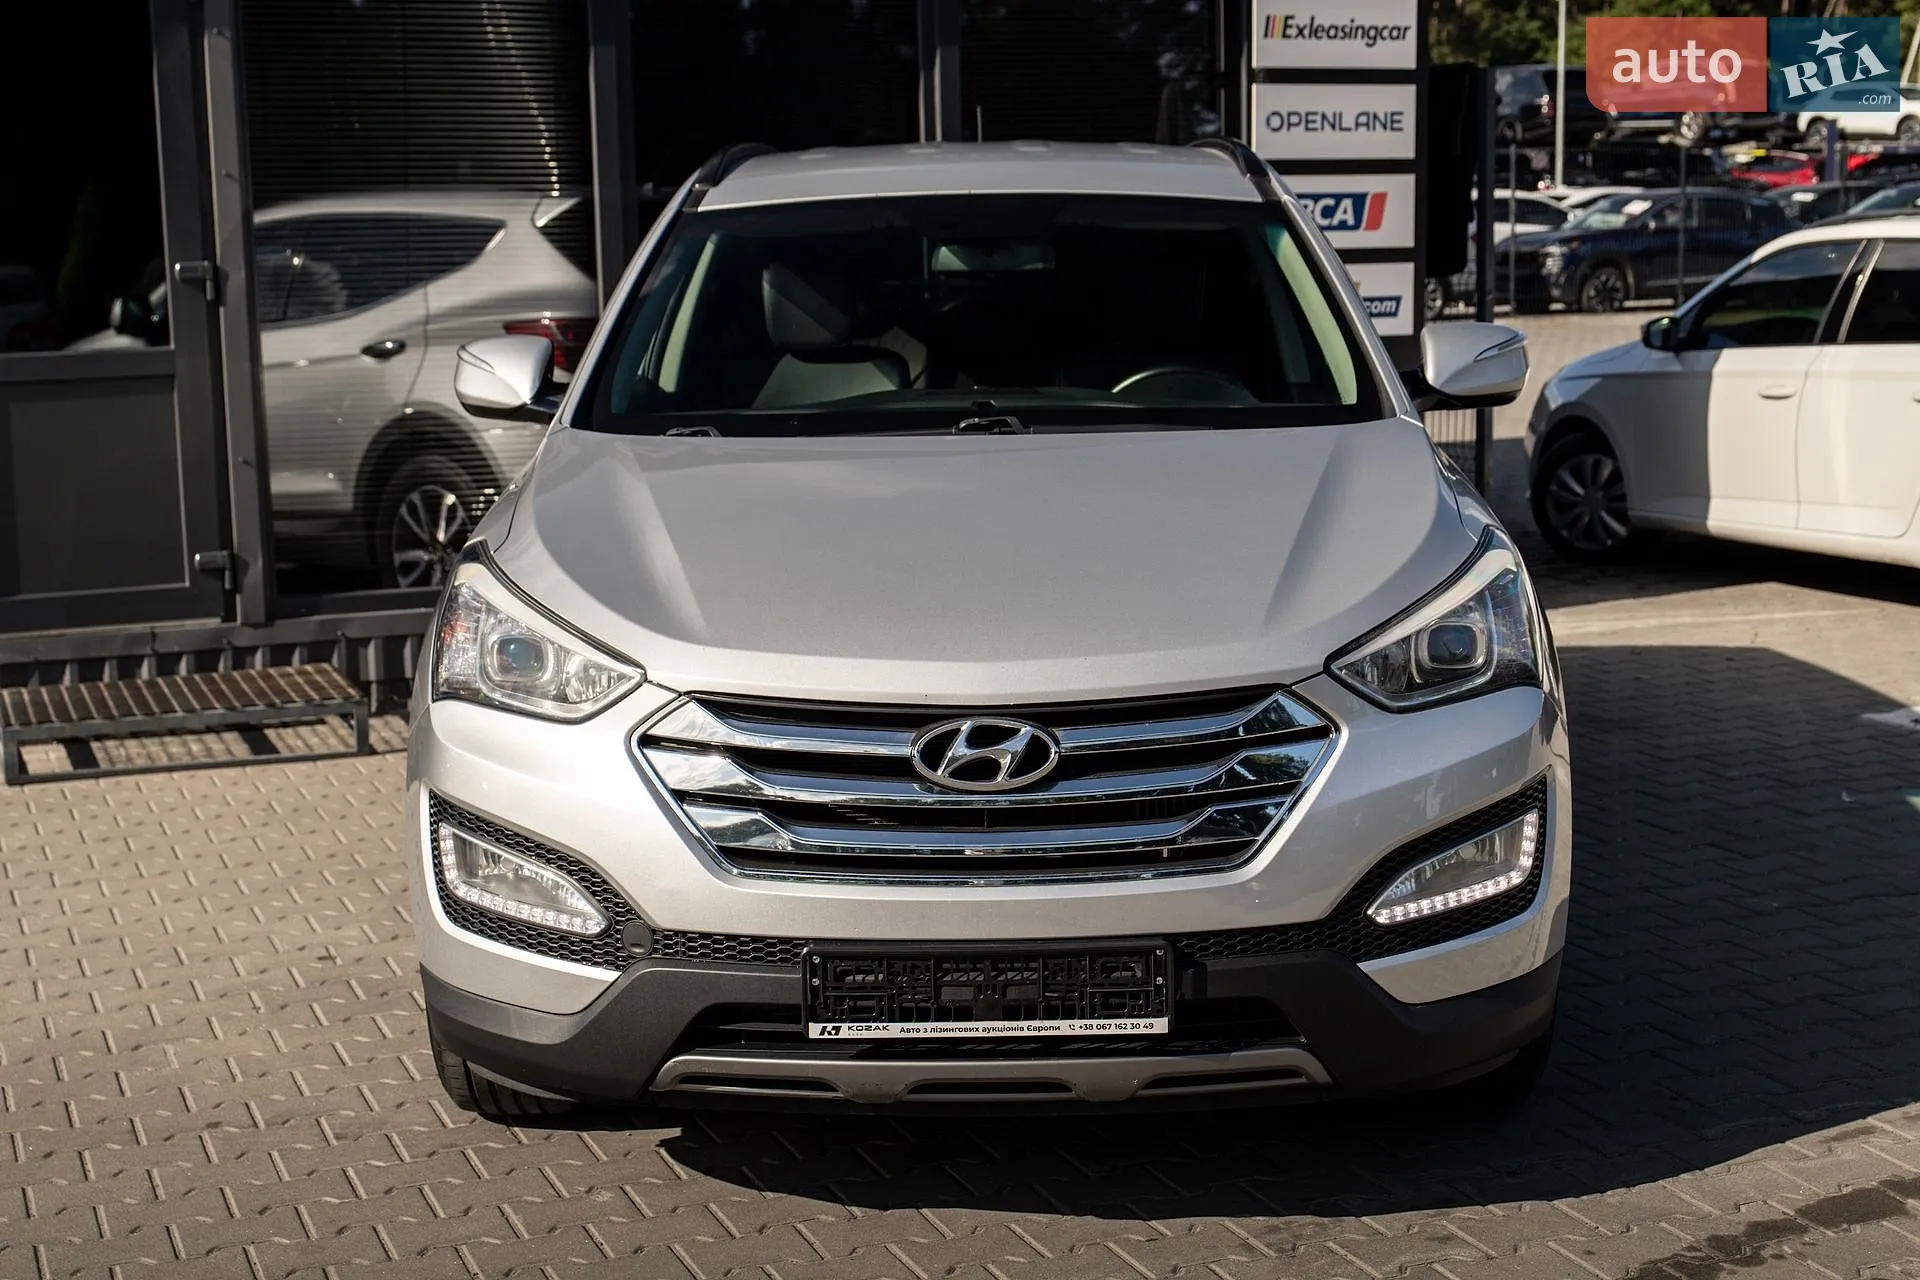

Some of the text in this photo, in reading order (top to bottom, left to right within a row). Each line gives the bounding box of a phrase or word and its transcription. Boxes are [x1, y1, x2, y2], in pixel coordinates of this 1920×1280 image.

[1281, 14, 1411, 48] Exleasingcar
[1265, 110, 1405, 133] OPENLANE
[847, 1024, 890, 1032] KOZAK
[899, 1026, 921, 1034] Авто
[930, 1026, 980, 1034] лізингових
[981, 1025, 1025, 1034] аукціонів
[1026, 1024, 1061, 1033] Європи
[1078, 1022, 1155, 1031] +38 067 162 30 49
